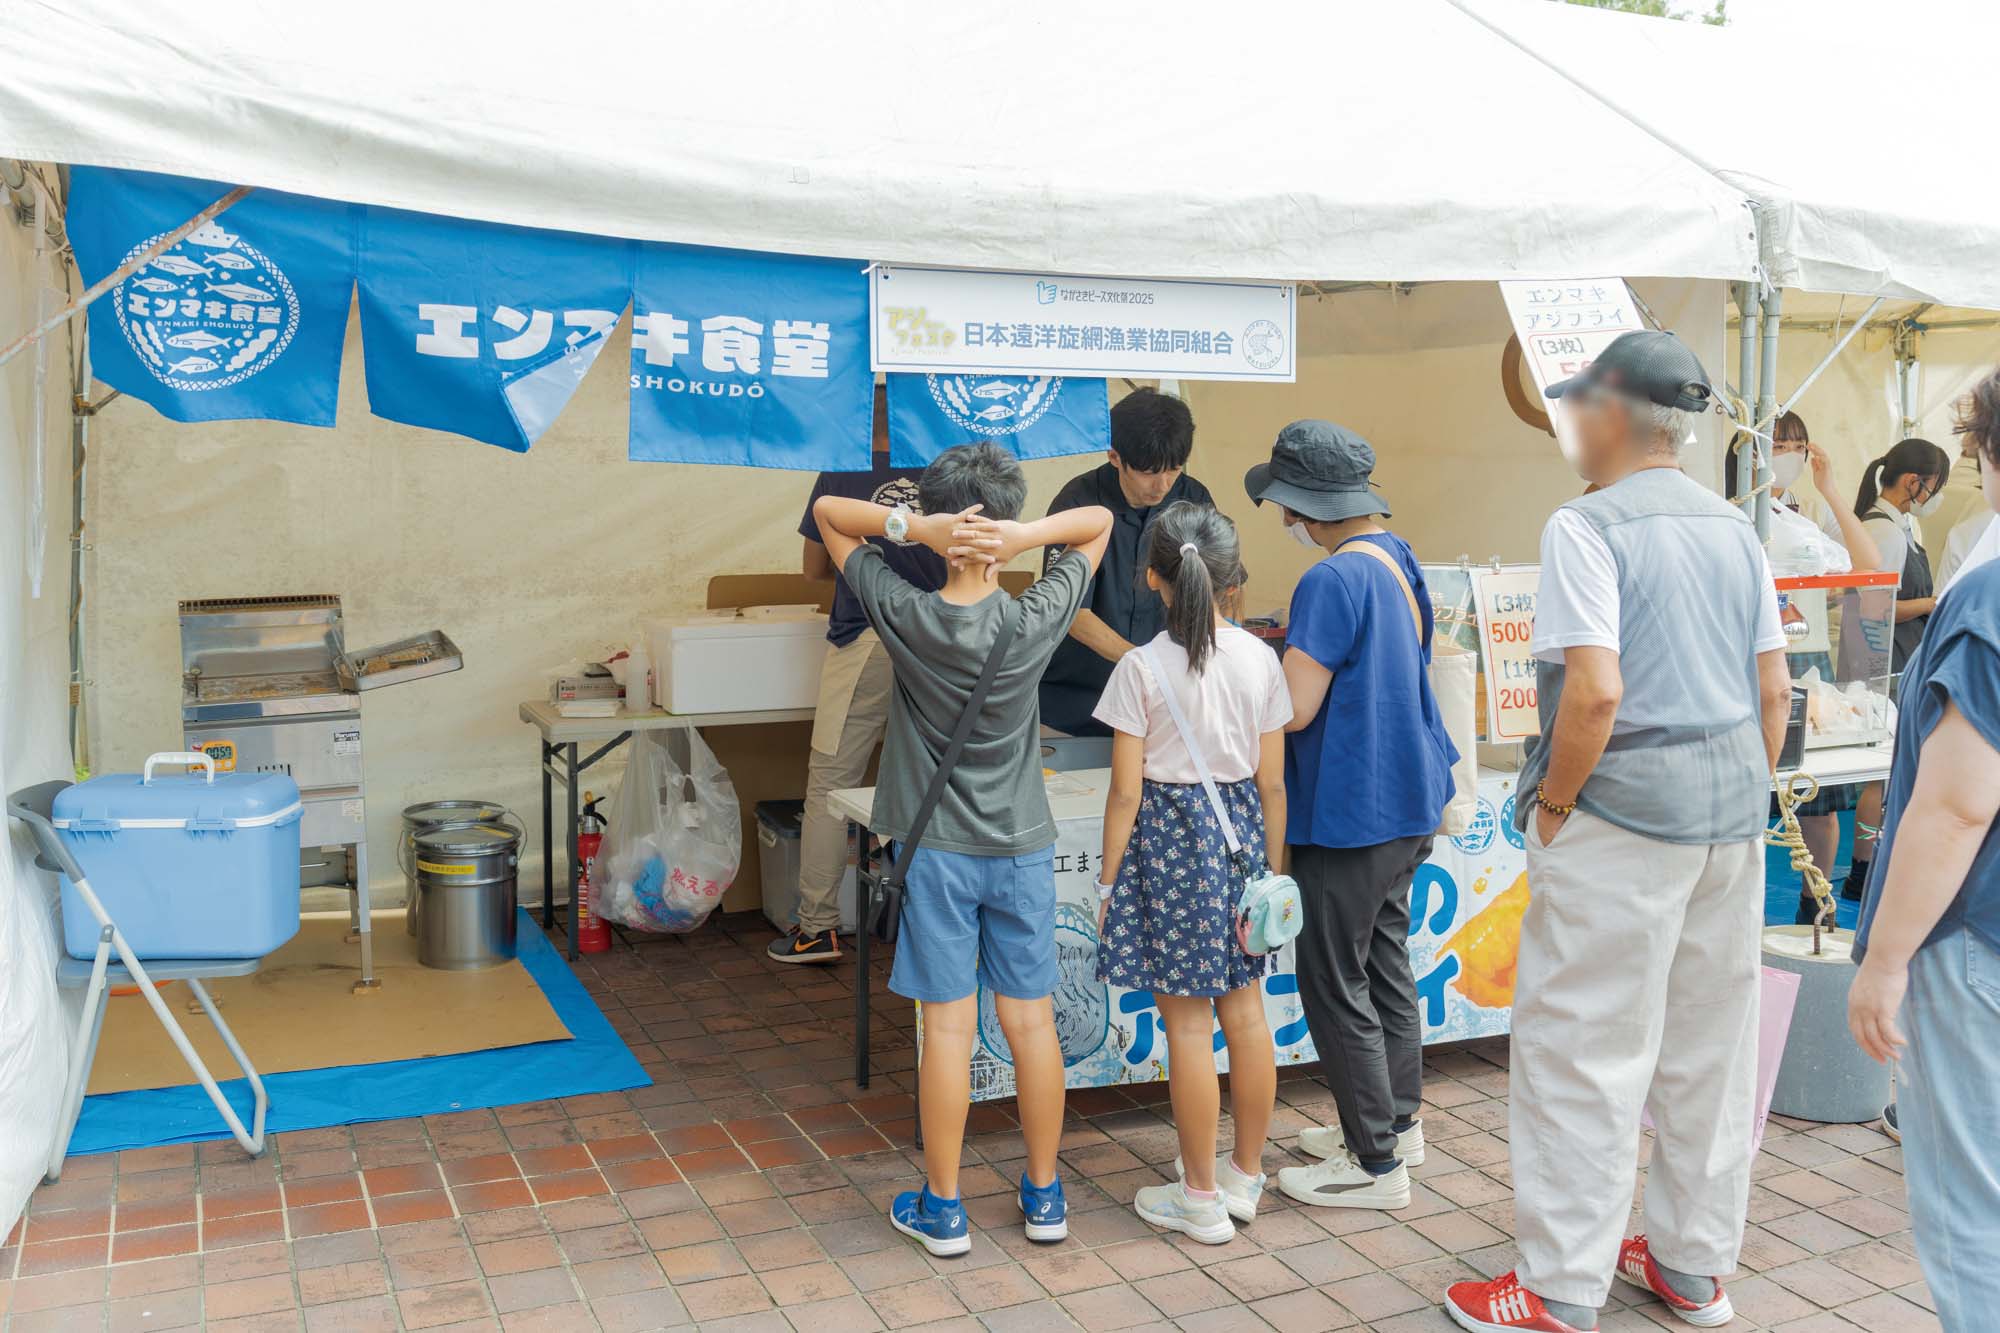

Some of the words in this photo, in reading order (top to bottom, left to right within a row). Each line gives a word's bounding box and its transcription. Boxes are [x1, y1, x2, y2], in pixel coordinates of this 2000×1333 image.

[1060, 289, 1154, 304] ながさきピース文化祭2025
[1526, 286, 1606, 304] エンマキ
[128, 293, 282, 324] エンマキ食堂
[1524, 308, 1623, 329] アジフライ
[964, 322, 1234, 355] 日本遠洋旋網漁業協同組合
[1491, 621, 1536, 644] 500
